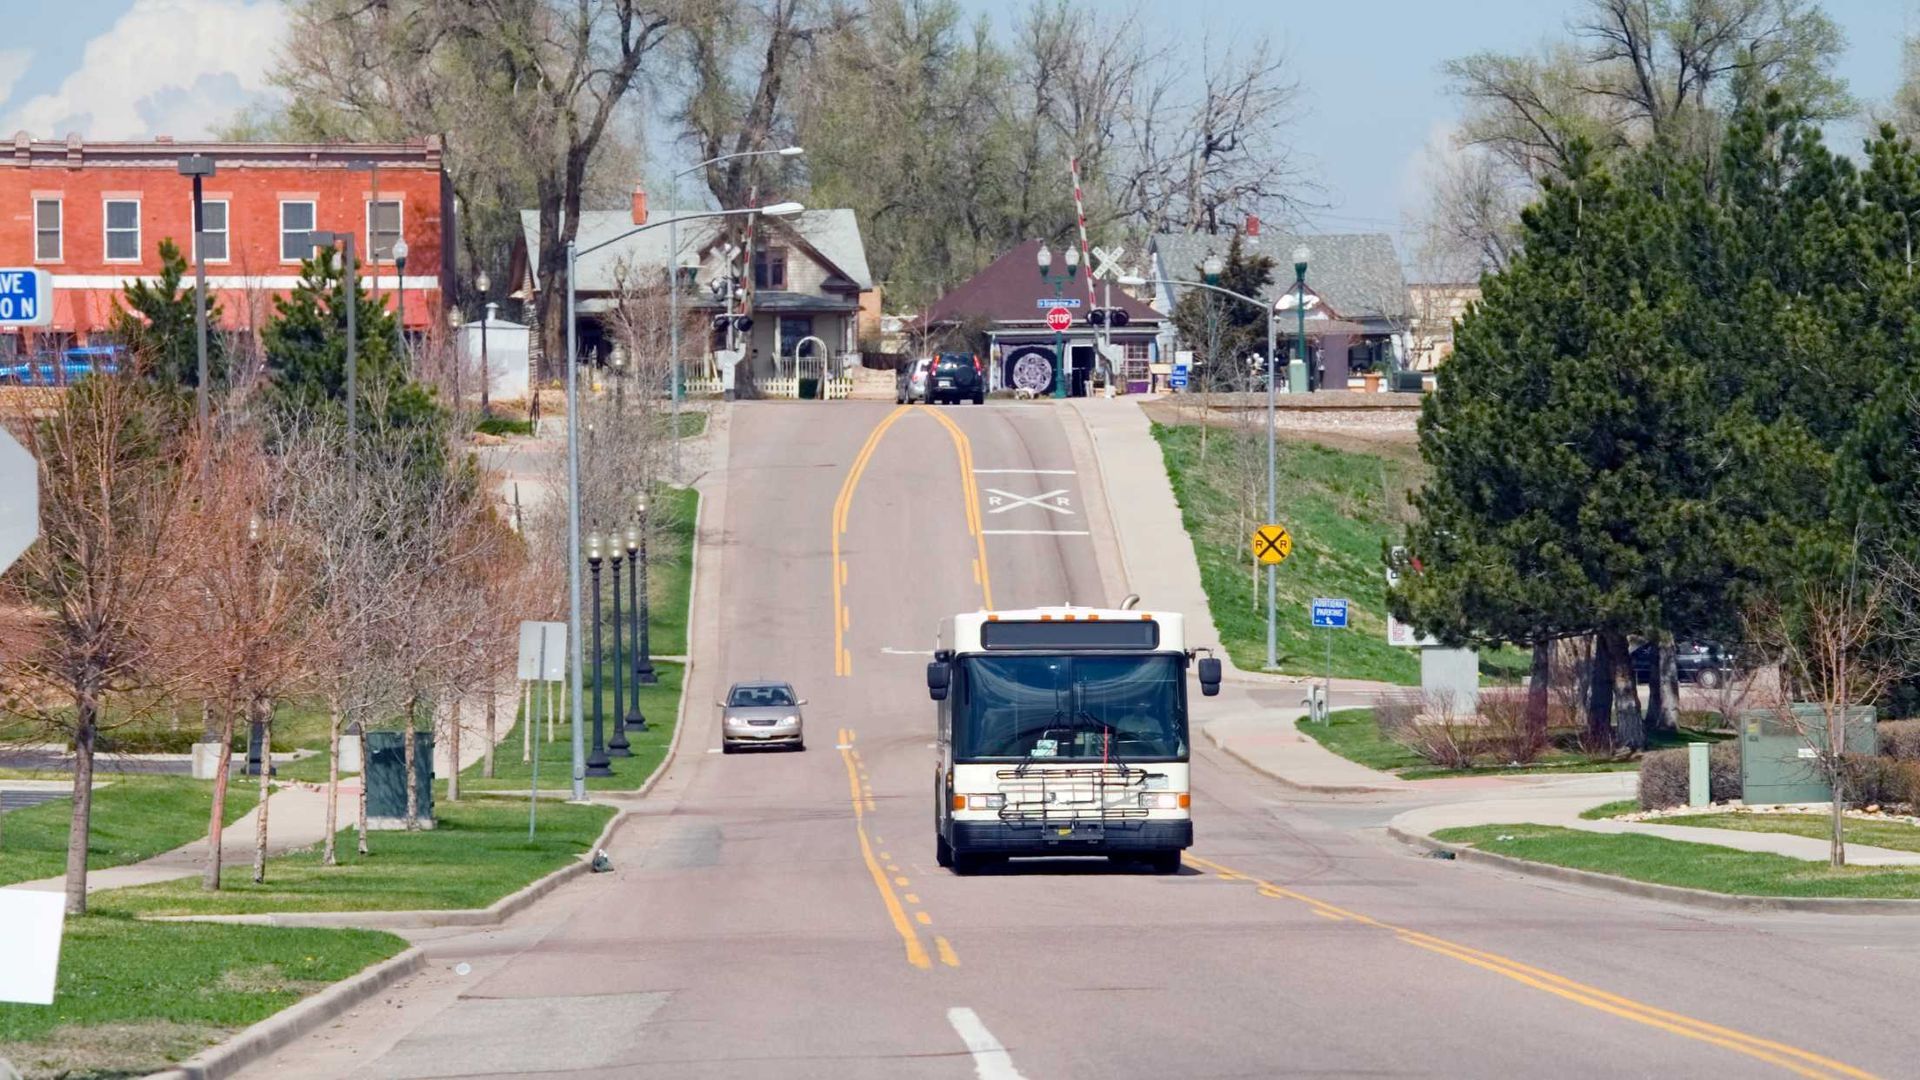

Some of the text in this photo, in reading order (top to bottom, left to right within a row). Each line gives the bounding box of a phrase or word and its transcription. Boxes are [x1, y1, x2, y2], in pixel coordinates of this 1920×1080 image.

[1049, 313, 1071, 324] STOP
[988, 496, 1071, 506] R R
[1255, 540, 1288, 549] R R
[1316, 608, 1344, 617] PARKING
